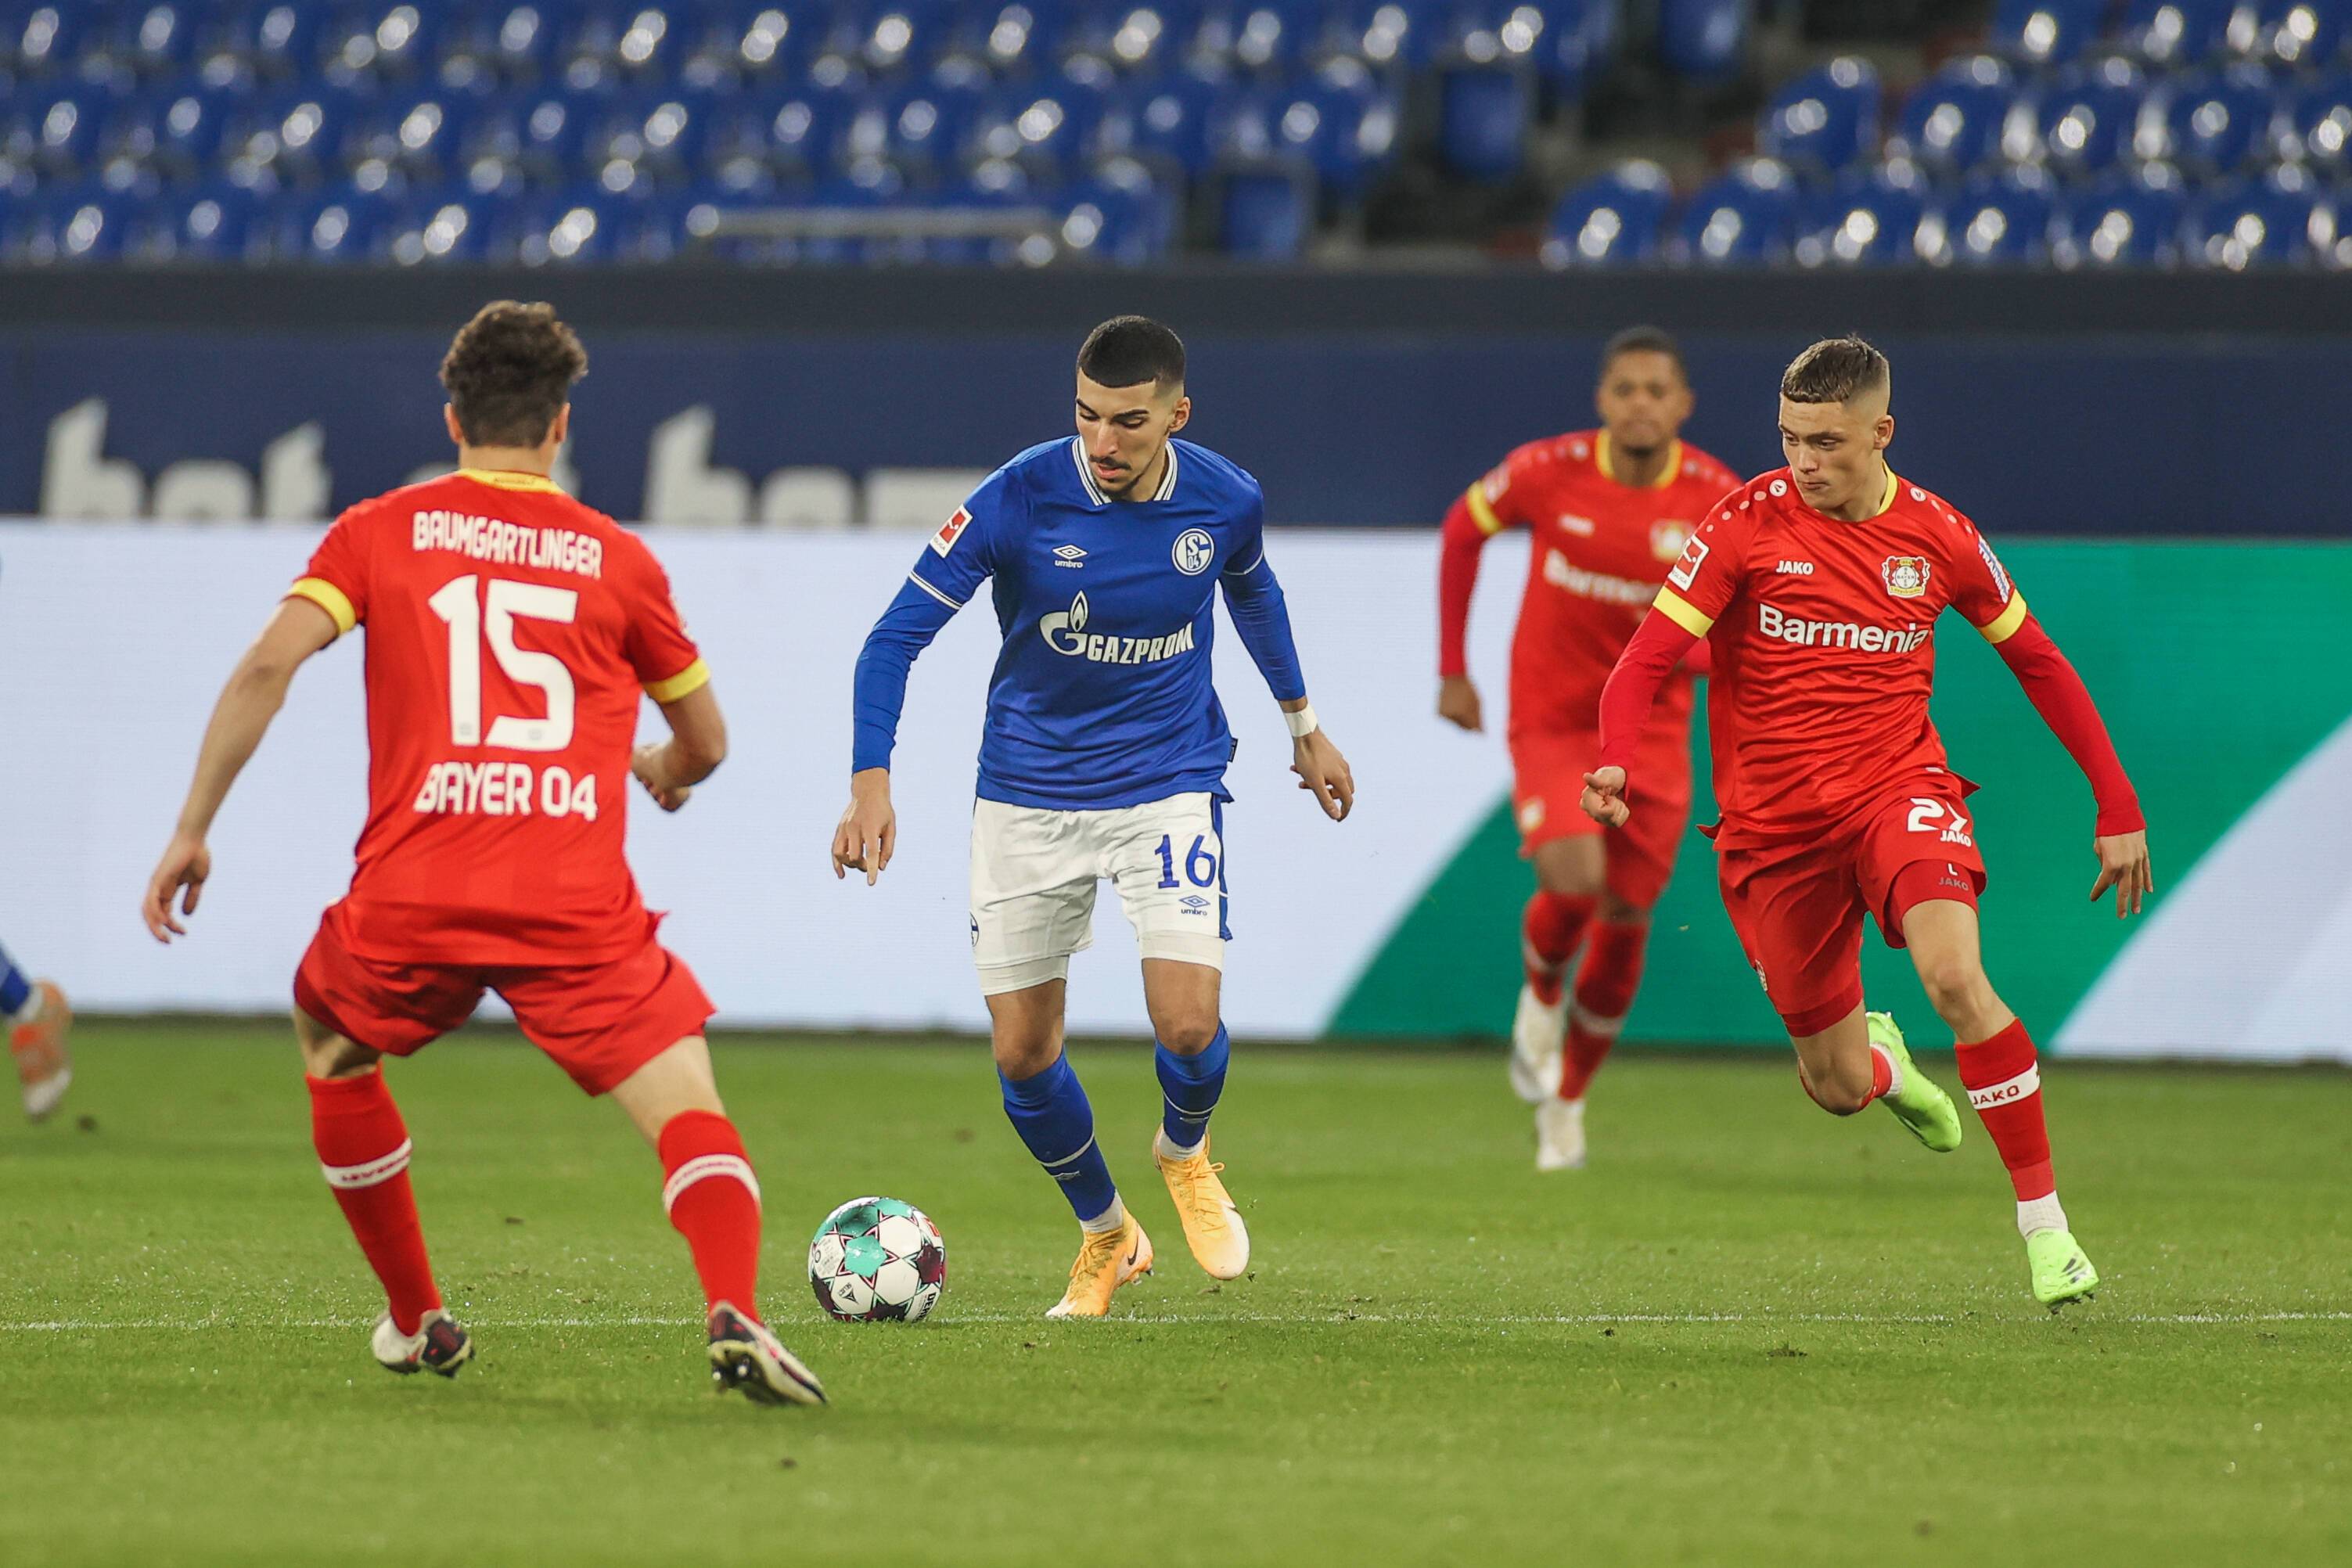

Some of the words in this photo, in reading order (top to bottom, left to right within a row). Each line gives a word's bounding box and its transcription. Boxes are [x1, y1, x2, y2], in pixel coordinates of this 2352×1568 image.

[412, 510, 602, 579] BAUMGARTLINGER
[1054, 559, 1084, 569] umbro
[1775, 559, 1814, 576] JAKO
[1087, 621, 1195, 664] GAZPROM
[1760, 602, 1929, 653] Barmenia
[428, 574, 579, 752] 15
[413, 761, 534, 815] BAYER
[540, 766, 599, 822] 04
[1940, 829, 1973, 848] JAKO
[1154, 833, 1217, 889] 16
[1937, 876, 1969, 891] JAKO
[1181, 908, 1208, 916] umbro
[1973, 1084, 2019, 1105] JAKO
